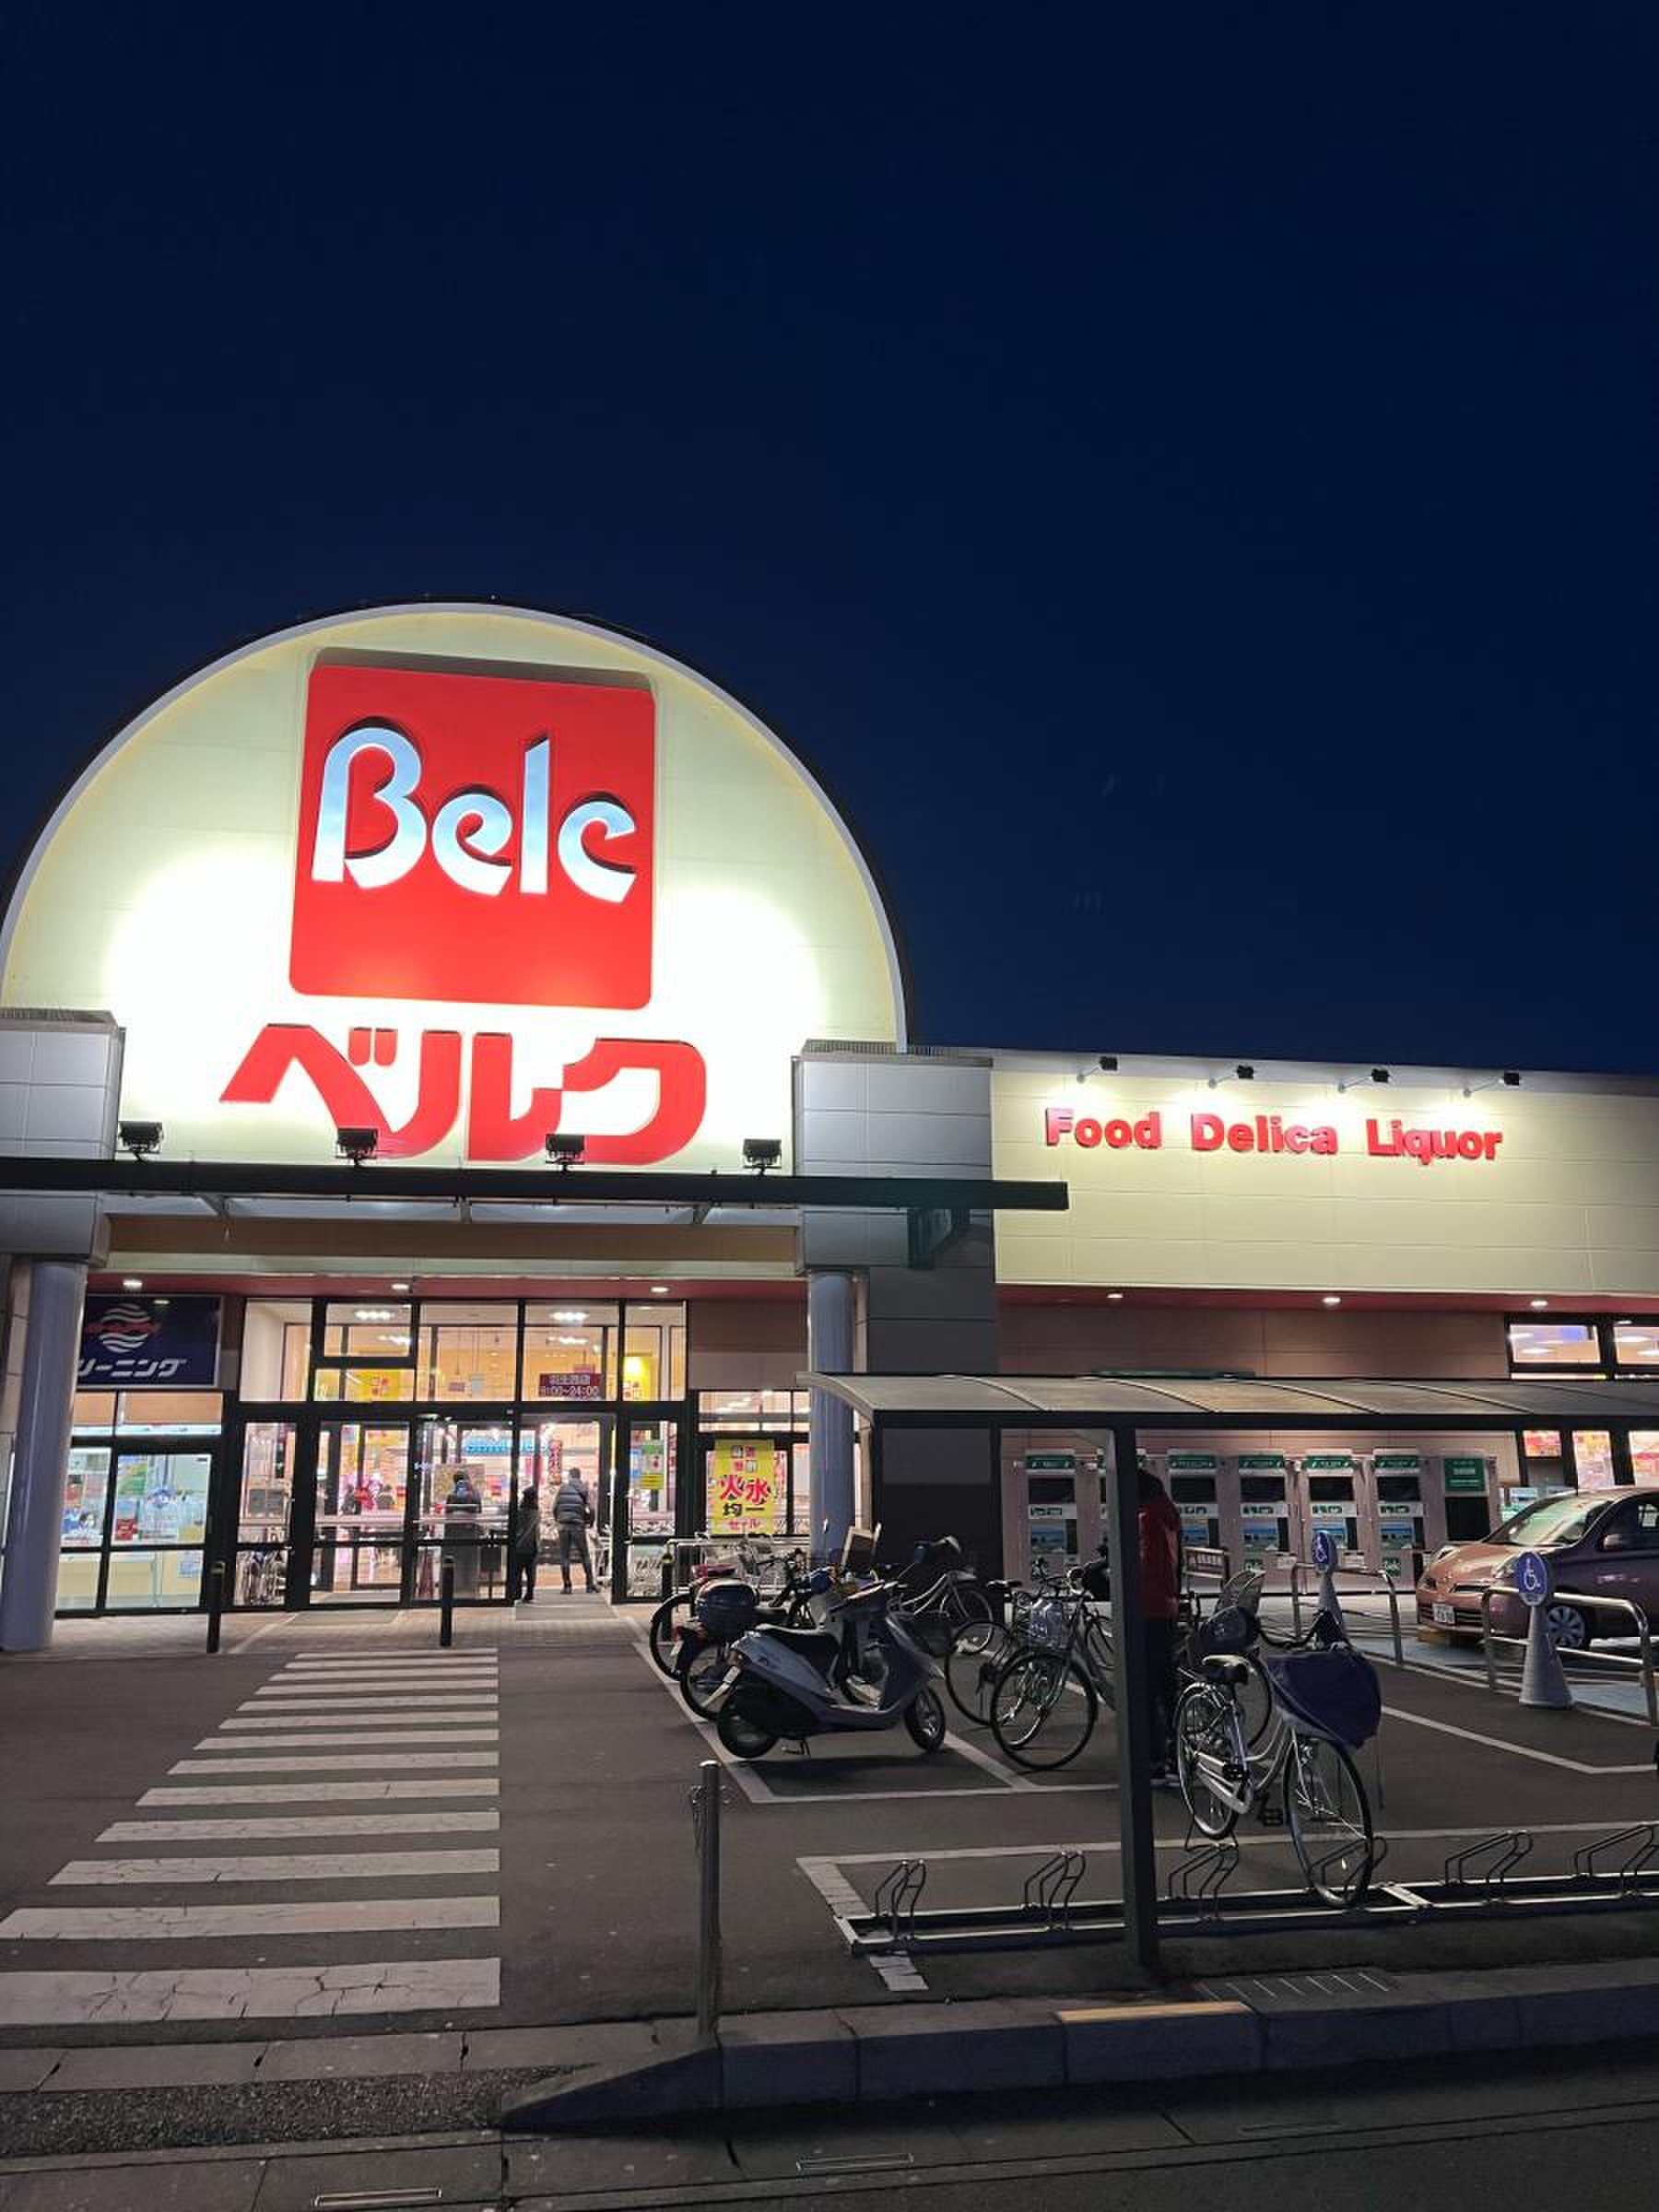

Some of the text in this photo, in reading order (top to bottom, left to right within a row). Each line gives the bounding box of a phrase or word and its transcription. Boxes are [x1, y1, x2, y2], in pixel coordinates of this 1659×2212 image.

[312, 719, 637, 903] Belc
[219, 1023, 707, 1165] ベルク
[1045, 1108, 1503, 1165] Food Delica Liquor
